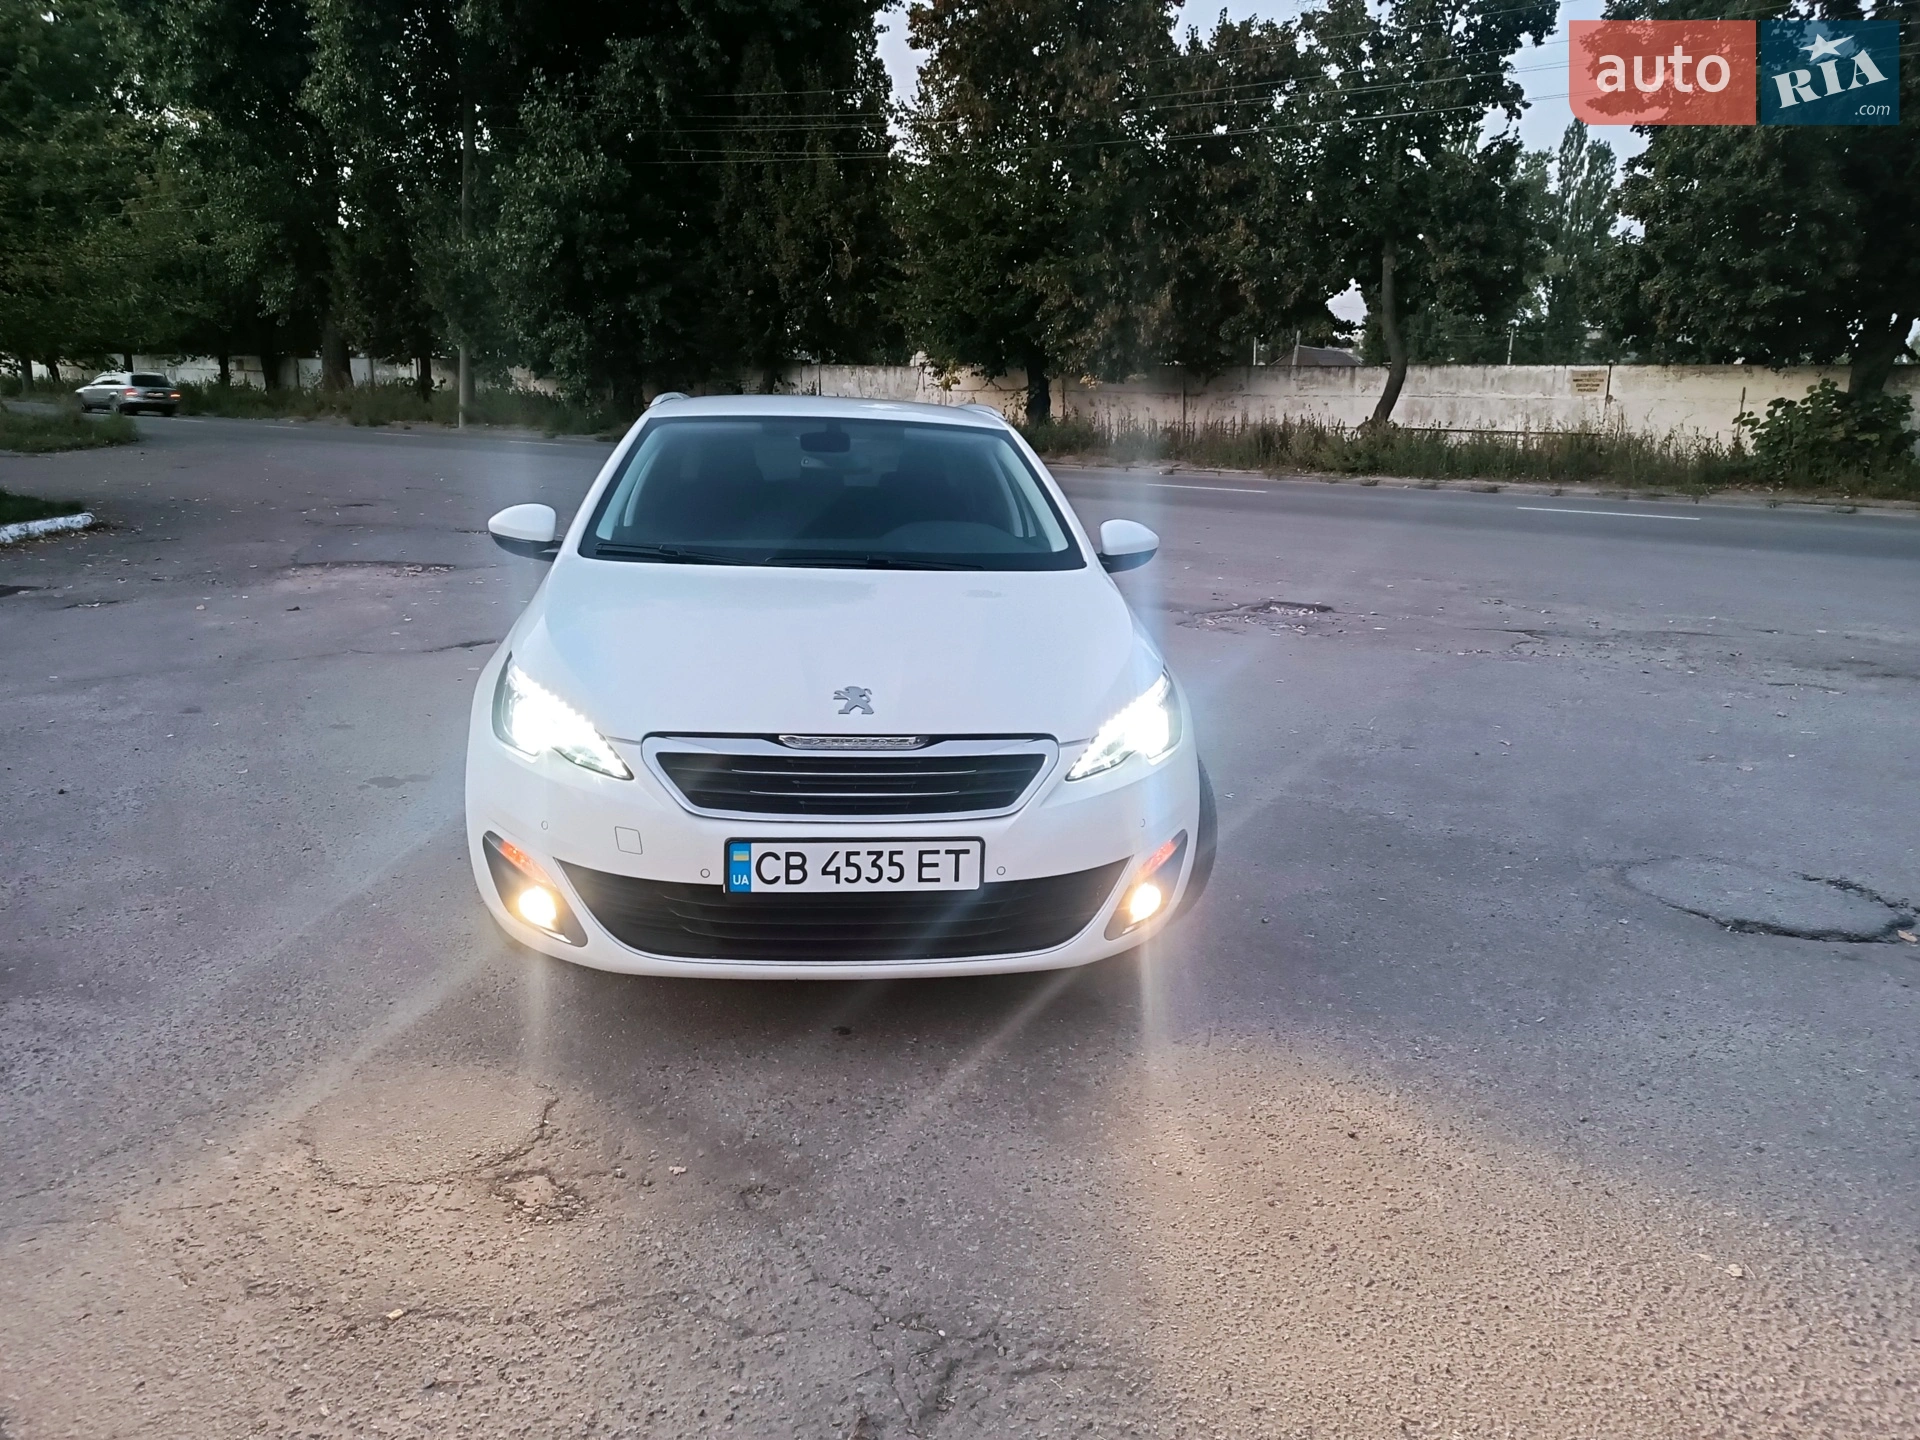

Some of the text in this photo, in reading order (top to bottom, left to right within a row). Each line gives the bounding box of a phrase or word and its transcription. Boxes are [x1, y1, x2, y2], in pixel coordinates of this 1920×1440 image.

[755, 849, 971, 885] CB 4535 ET
[732, 874, 750, 885] UA
